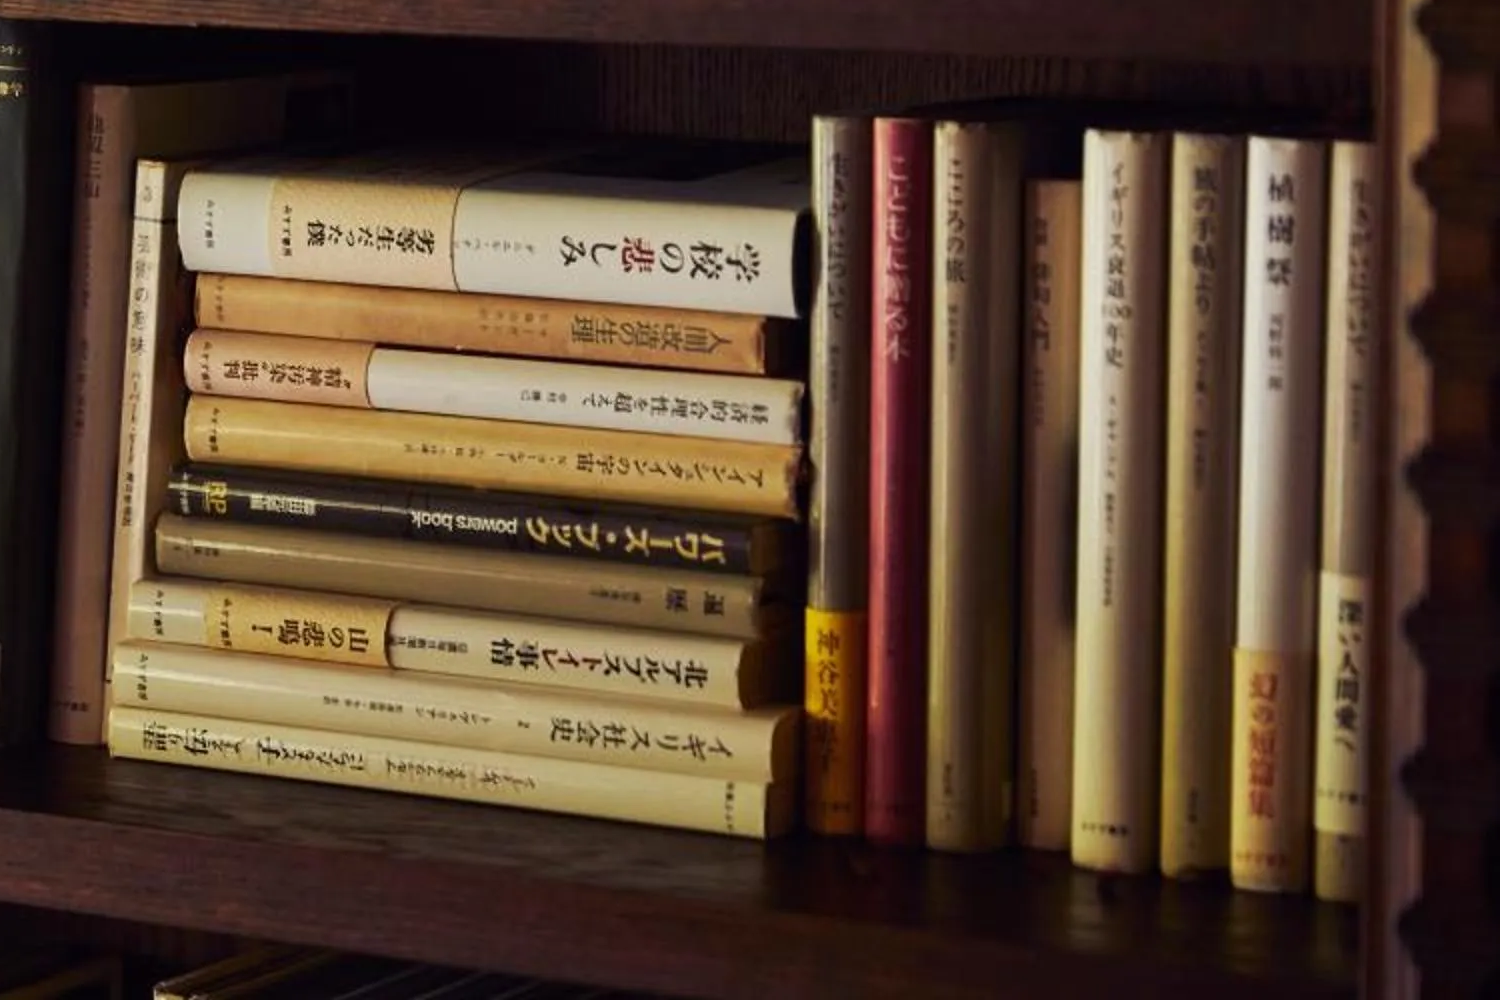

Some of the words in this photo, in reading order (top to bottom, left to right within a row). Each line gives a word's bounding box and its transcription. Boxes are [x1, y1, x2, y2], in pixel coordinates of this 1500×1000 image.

[281, 204, 293, 257] みすず書房
[305, 219, 436, 256] 劣等生だった僕
[1265, 174, 1296, 288] 植樹祭
[559, 236, 762, 283] 学校の悲しみ
[570, 317, 733, 354] 人間改造の生理
[209, 407, 220, 453] みすず書房
[581, 391, 770, 426] 経済的合理性を超えて
[575, 452, 765, 488] アインシュタインの宇宙
[410, 508, 453, 526] book
[524, 516, 724, 564] パワーズ・ブック
[154, 590, 165, 635] みすず書房
[220, 598, 233, 648] みすず書房
[137, 653, 149, 701] みすず書房
[490, 637, 708, 690] 北アルプストイレ事情
[1336, 600, 1364, 753] 深い人間愛へ
[550, 717, 733, 762] イギリス社会史
